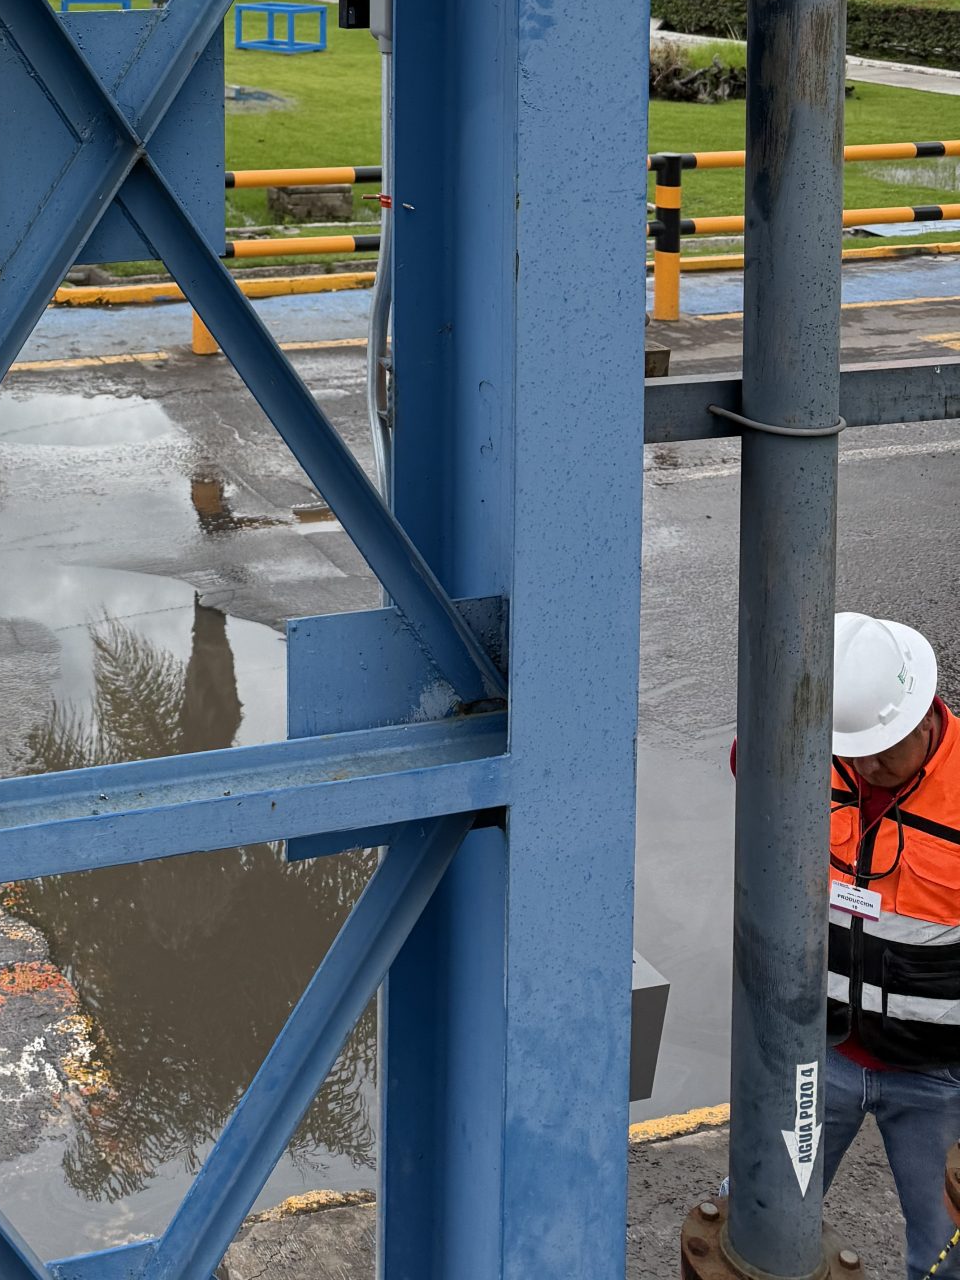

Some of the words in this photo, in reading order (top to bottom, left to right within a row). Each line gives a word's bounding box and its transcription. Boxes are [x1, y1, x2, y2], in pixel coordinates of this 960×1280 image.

[837, 893, 874, 909] PRODUCCION
[800, 1067, 815, 1078] 4
[799, 1081, 815, 1121] POZO
[798, 1122, 813, 1164] AGUA
